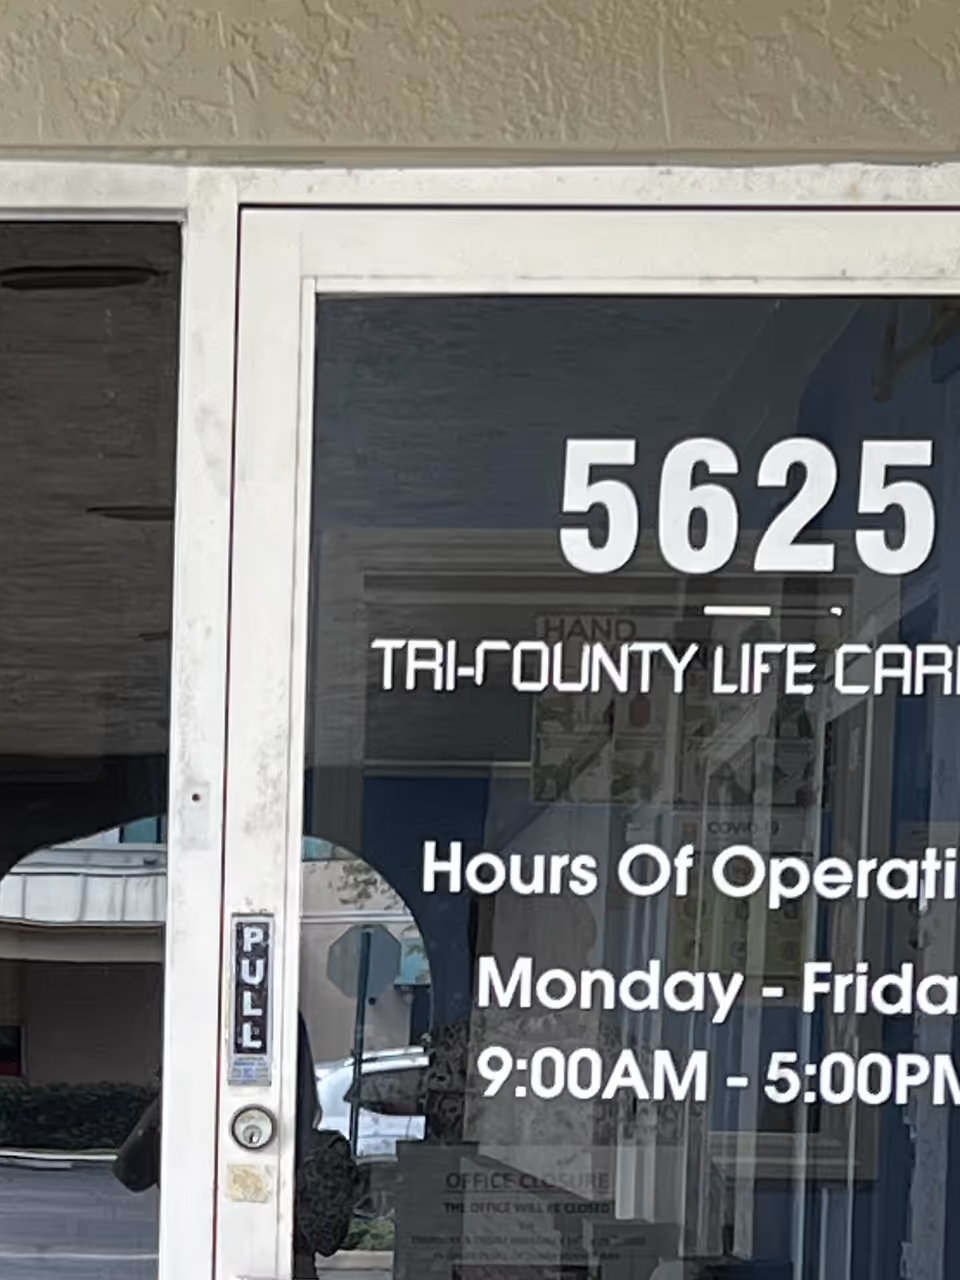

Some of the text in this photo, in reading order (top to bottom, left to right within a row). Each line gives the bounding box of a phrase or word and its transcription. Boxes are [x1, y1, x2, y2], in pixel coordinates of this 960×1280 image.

[560, 437, 935, 575] 5625
[543, 618, 638, 641] HAND
[713, 643, 816, 695] LIFE
[834, 643, 960, 695] CAR
[423, 841, 598, 896] Hours
[618, 843, 694, 896] Of
[240, 925, 265, 1050] PULL
[478, 956, 744, 1024] Monday
[762, 987, 784, 997] -
[477, 1045, 708, 1101] 9:00AM
[727, 1076, 749, 1087] -
[446, 1172, 517, 1189] OFFICE
